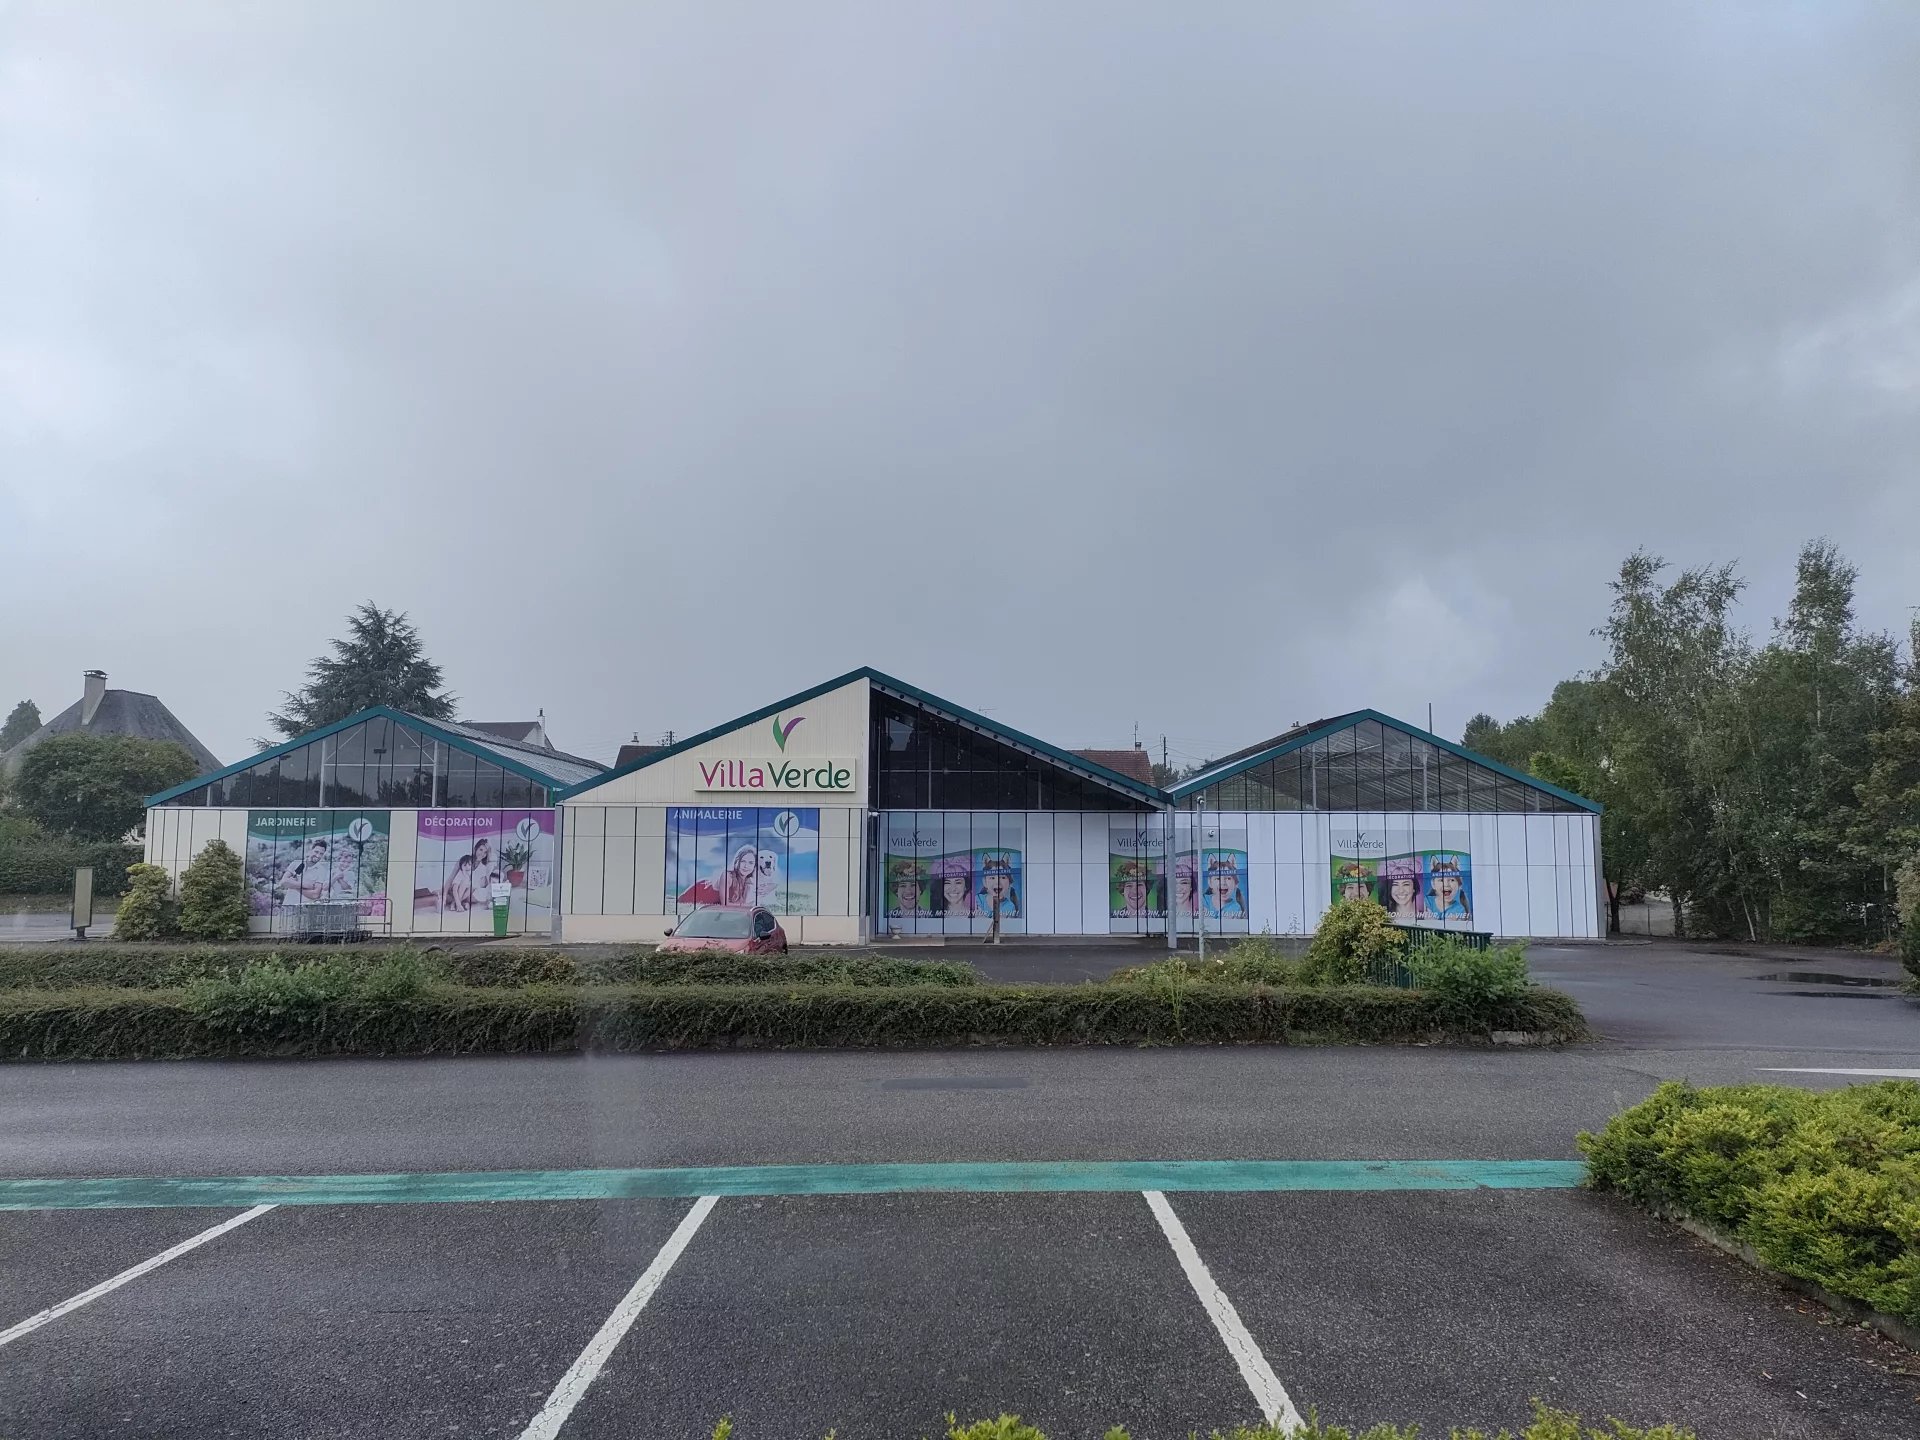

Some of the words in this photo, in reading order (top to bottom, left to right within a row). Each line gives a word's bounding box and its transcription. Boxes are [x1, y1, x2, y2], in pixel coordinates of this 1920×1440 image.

[699, 760, 764, 788] Villa
[767, 760, 850, 788] Verde
[674, 810, 743, 820] ANIMALERIE
[255, 817, 317, 827] JARDINERIE
[424, 815, 493, 827] DÉCORATION
